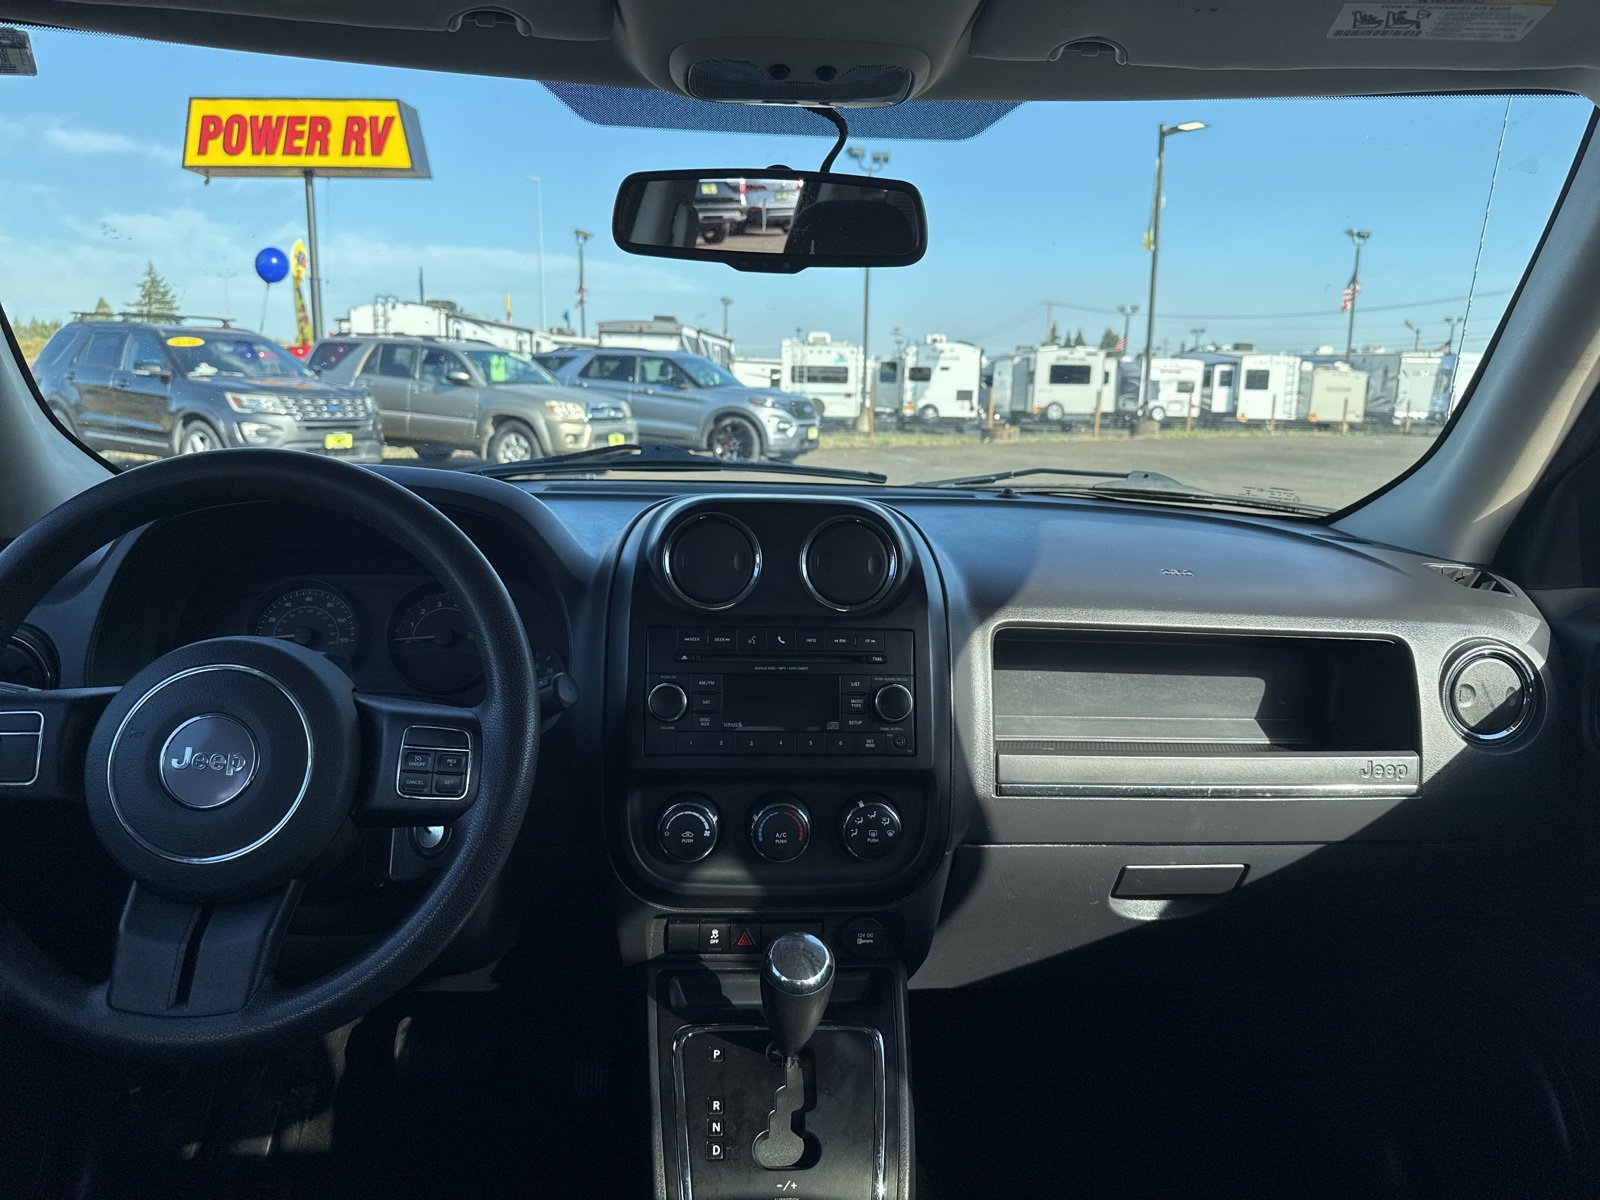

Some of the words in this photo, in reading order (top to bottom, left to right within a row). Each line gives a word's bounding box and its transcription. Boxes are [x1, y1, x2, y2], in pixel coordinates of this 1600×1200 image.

[197, 114, 332, 157] POWER
[341, 115, 395, 157] RV
[171, 746, 246, 776] Jeep
[1360, 760, 1408, 782] Jeep
[775, 831, 788, 839] A/C
[712, 1049, 721, 1060] P
[712, 1101, 721, 1112] R
[712, 1122, 721, 1134] N
[712, 1145, 721, 1156] D
